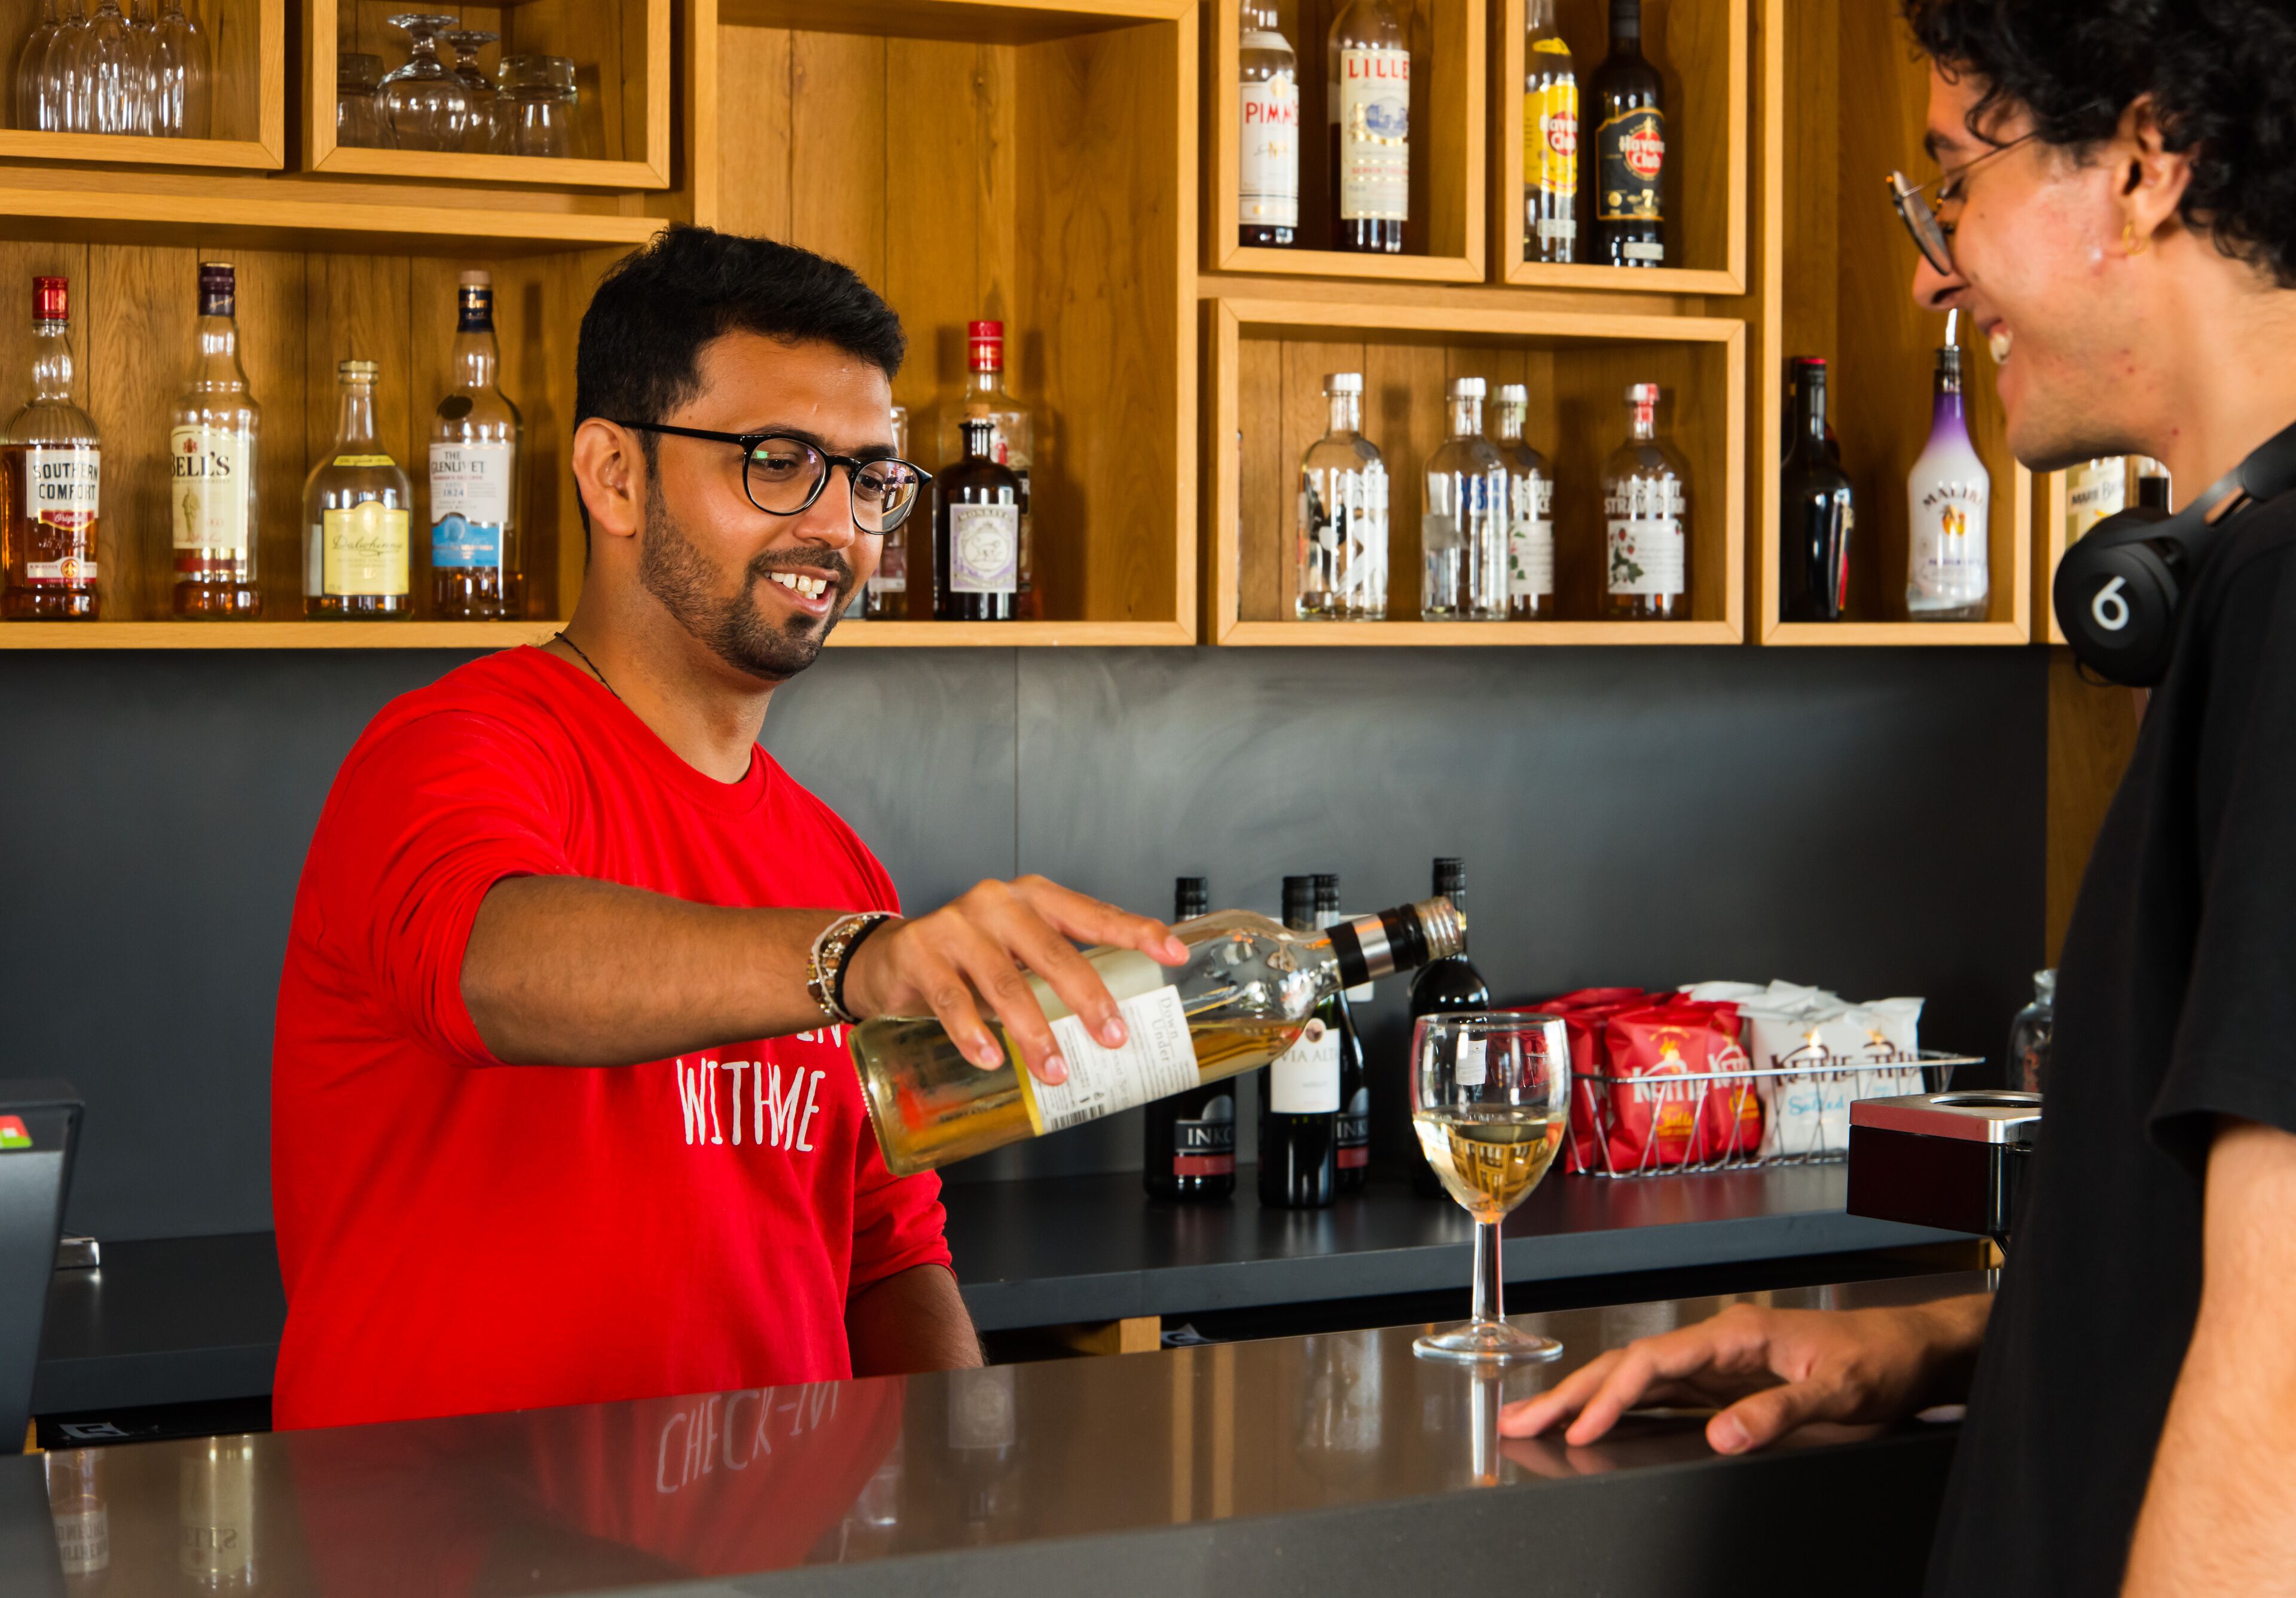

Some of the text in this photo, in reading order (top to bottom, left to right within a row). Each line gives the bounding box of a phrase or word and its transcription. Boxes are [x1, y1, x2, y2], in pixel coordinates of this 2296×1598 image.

[1631, 151, 1660, 168] Club
[445, 451, 461, 460] THE
[33, 463, 98, 481] SOUTHERN
[431, 461, 486, 474] GLENLIVET
[39, 483, 96, 500] COMFORT
[443, 488, 464, 497] 1824
[1161, 997, 1178, 1039] Down
[1152, 1018, 1171, 1062] Under
